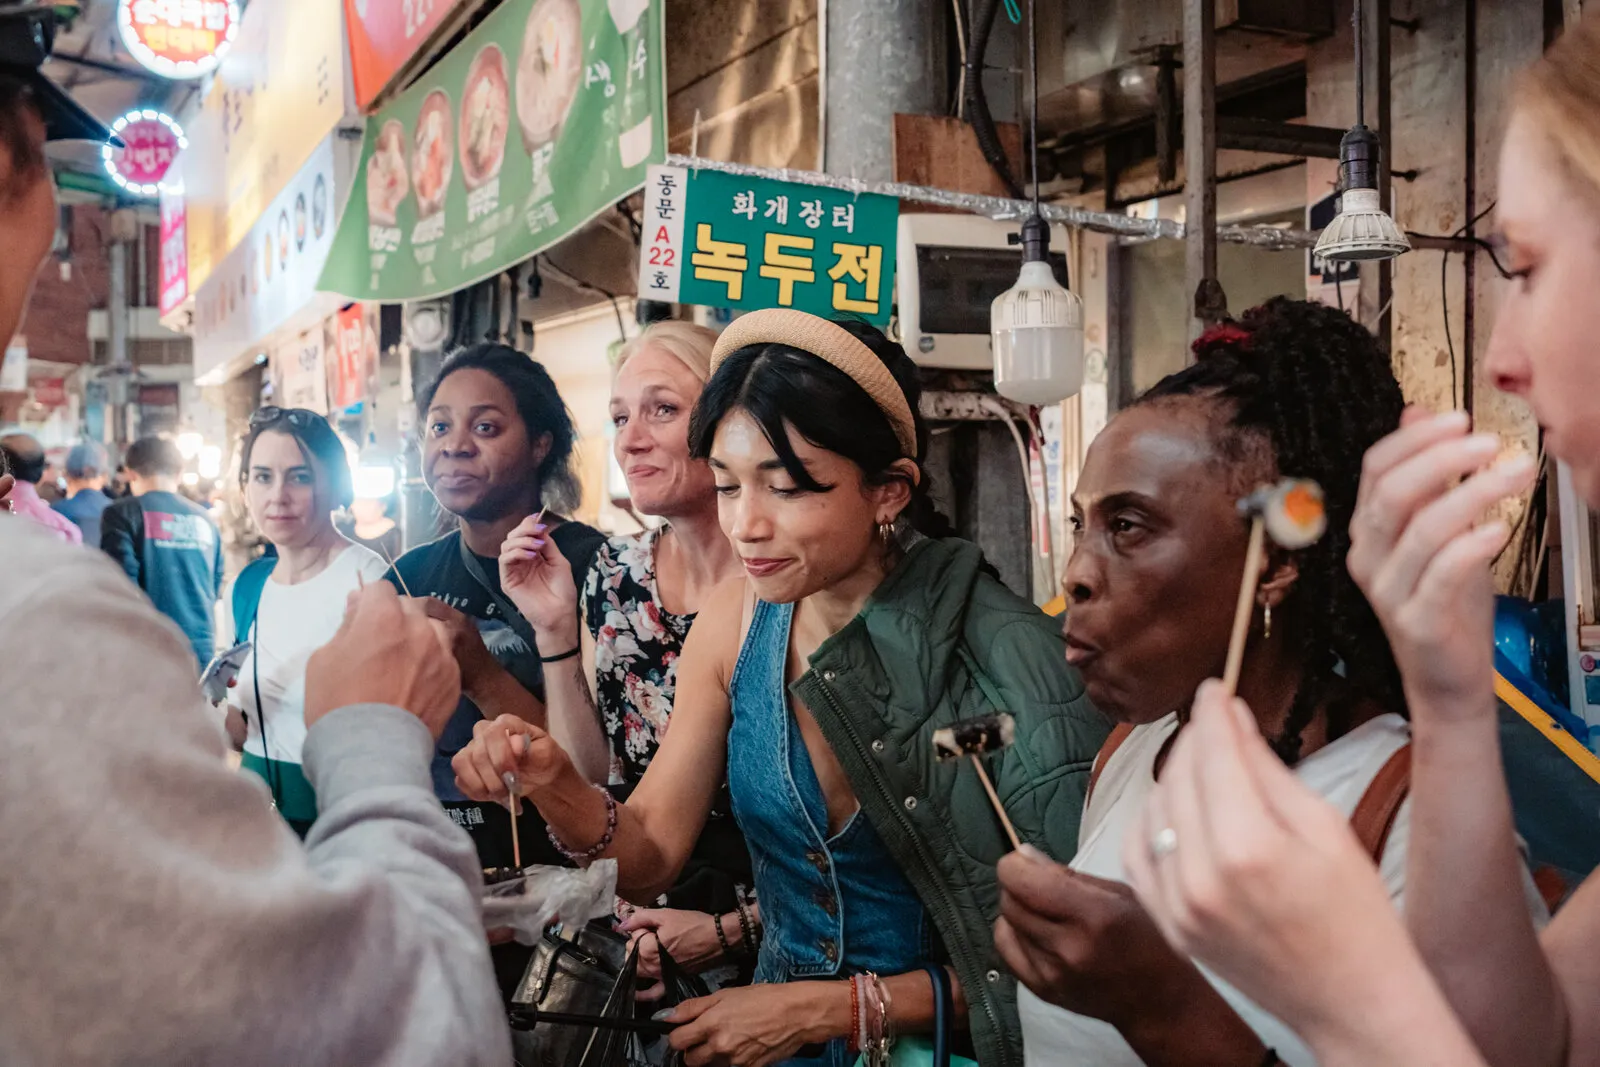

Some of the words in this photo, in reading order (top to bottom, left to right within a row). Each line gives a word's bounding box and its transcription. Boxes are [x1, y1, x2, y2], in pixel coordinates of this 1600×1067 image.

[732, 190, 855, 234] 화개장터
[649, 246, 675, 267] 22
[691, 223, 883, 315] 녹두전
